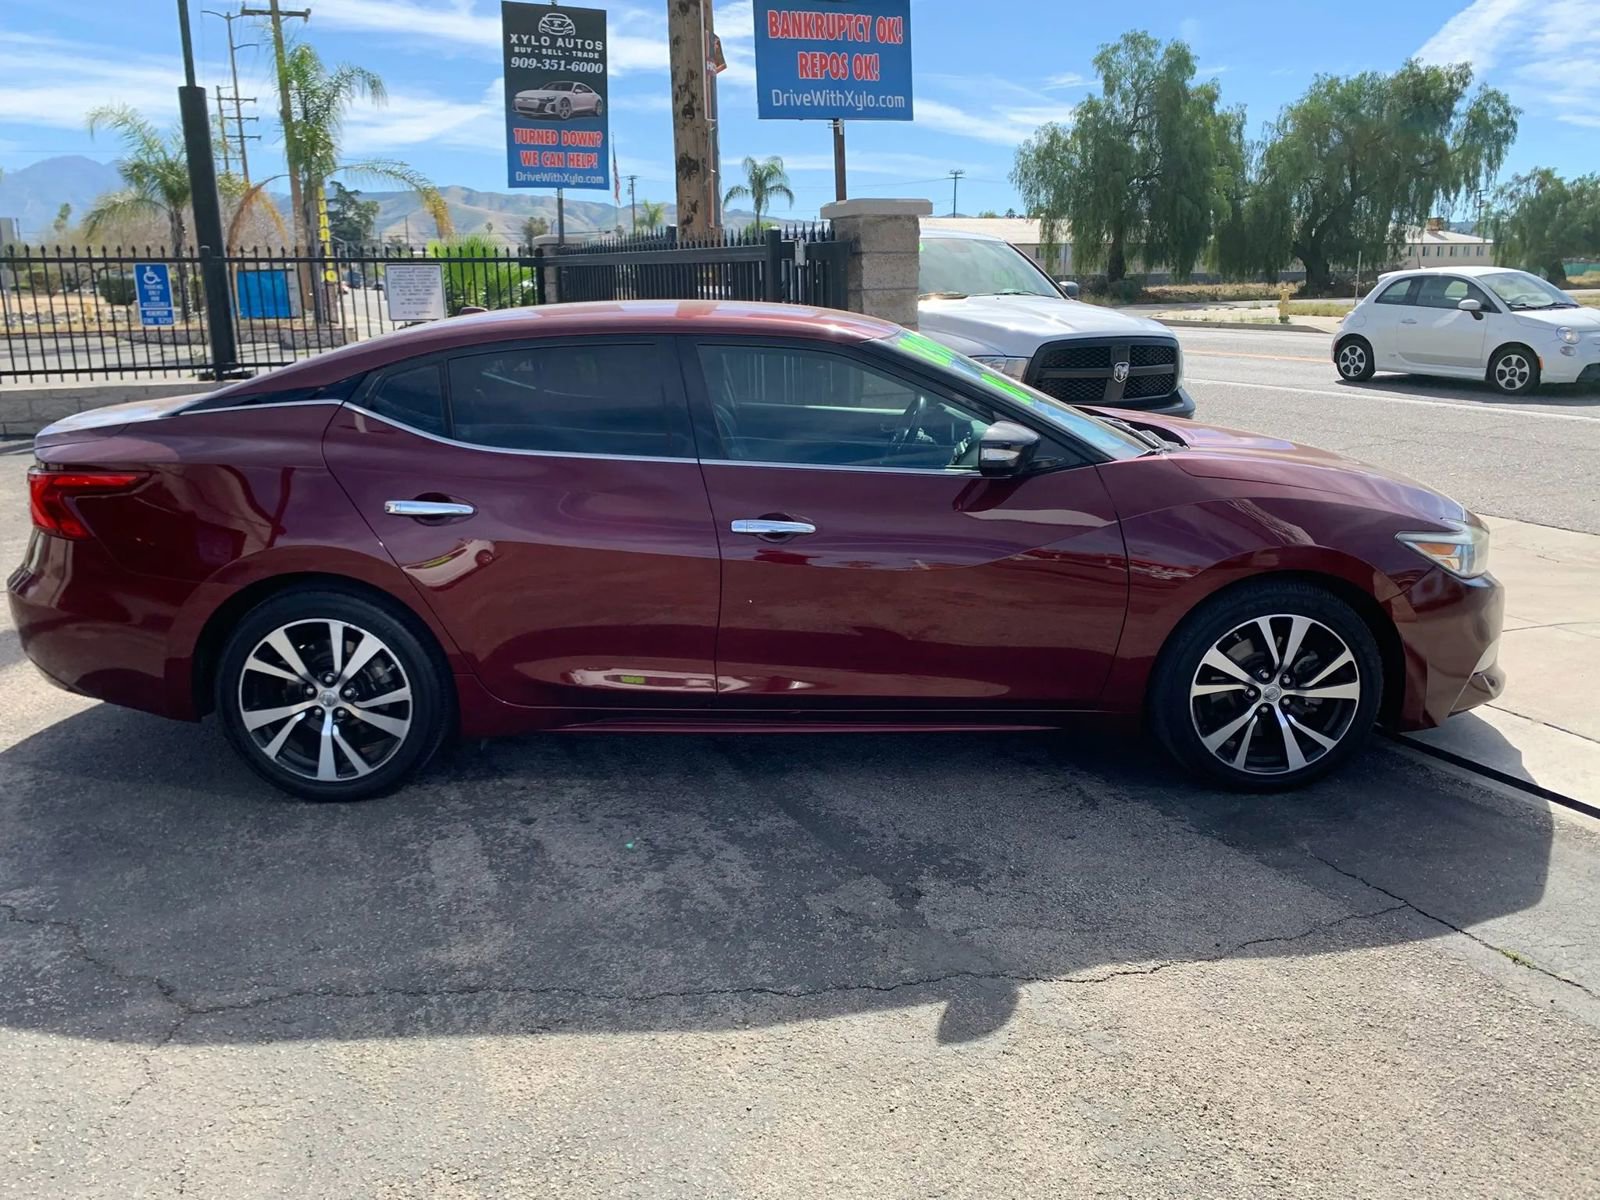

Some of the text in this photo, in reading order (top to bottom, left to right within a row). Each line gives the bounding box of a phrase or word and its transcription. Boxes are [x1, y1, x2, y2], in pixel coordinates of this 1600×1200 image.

[768, 10, 903, 44] BANKRUPTCY OK!
[510, 33, 603, 50] XYLO AUTOS
[510, 57, 603, 73] 909-351-6000
[798, 51, 880, 82] REPOS OK!
[772, 89, 905, 110] DriveWithXylo.com
[513, 128, 603, 147] TURNED DOWN?
[520, 150, 598, 169] WE CAN HELP!
[516, 171, 604, 185] DriveWithXylo.com
